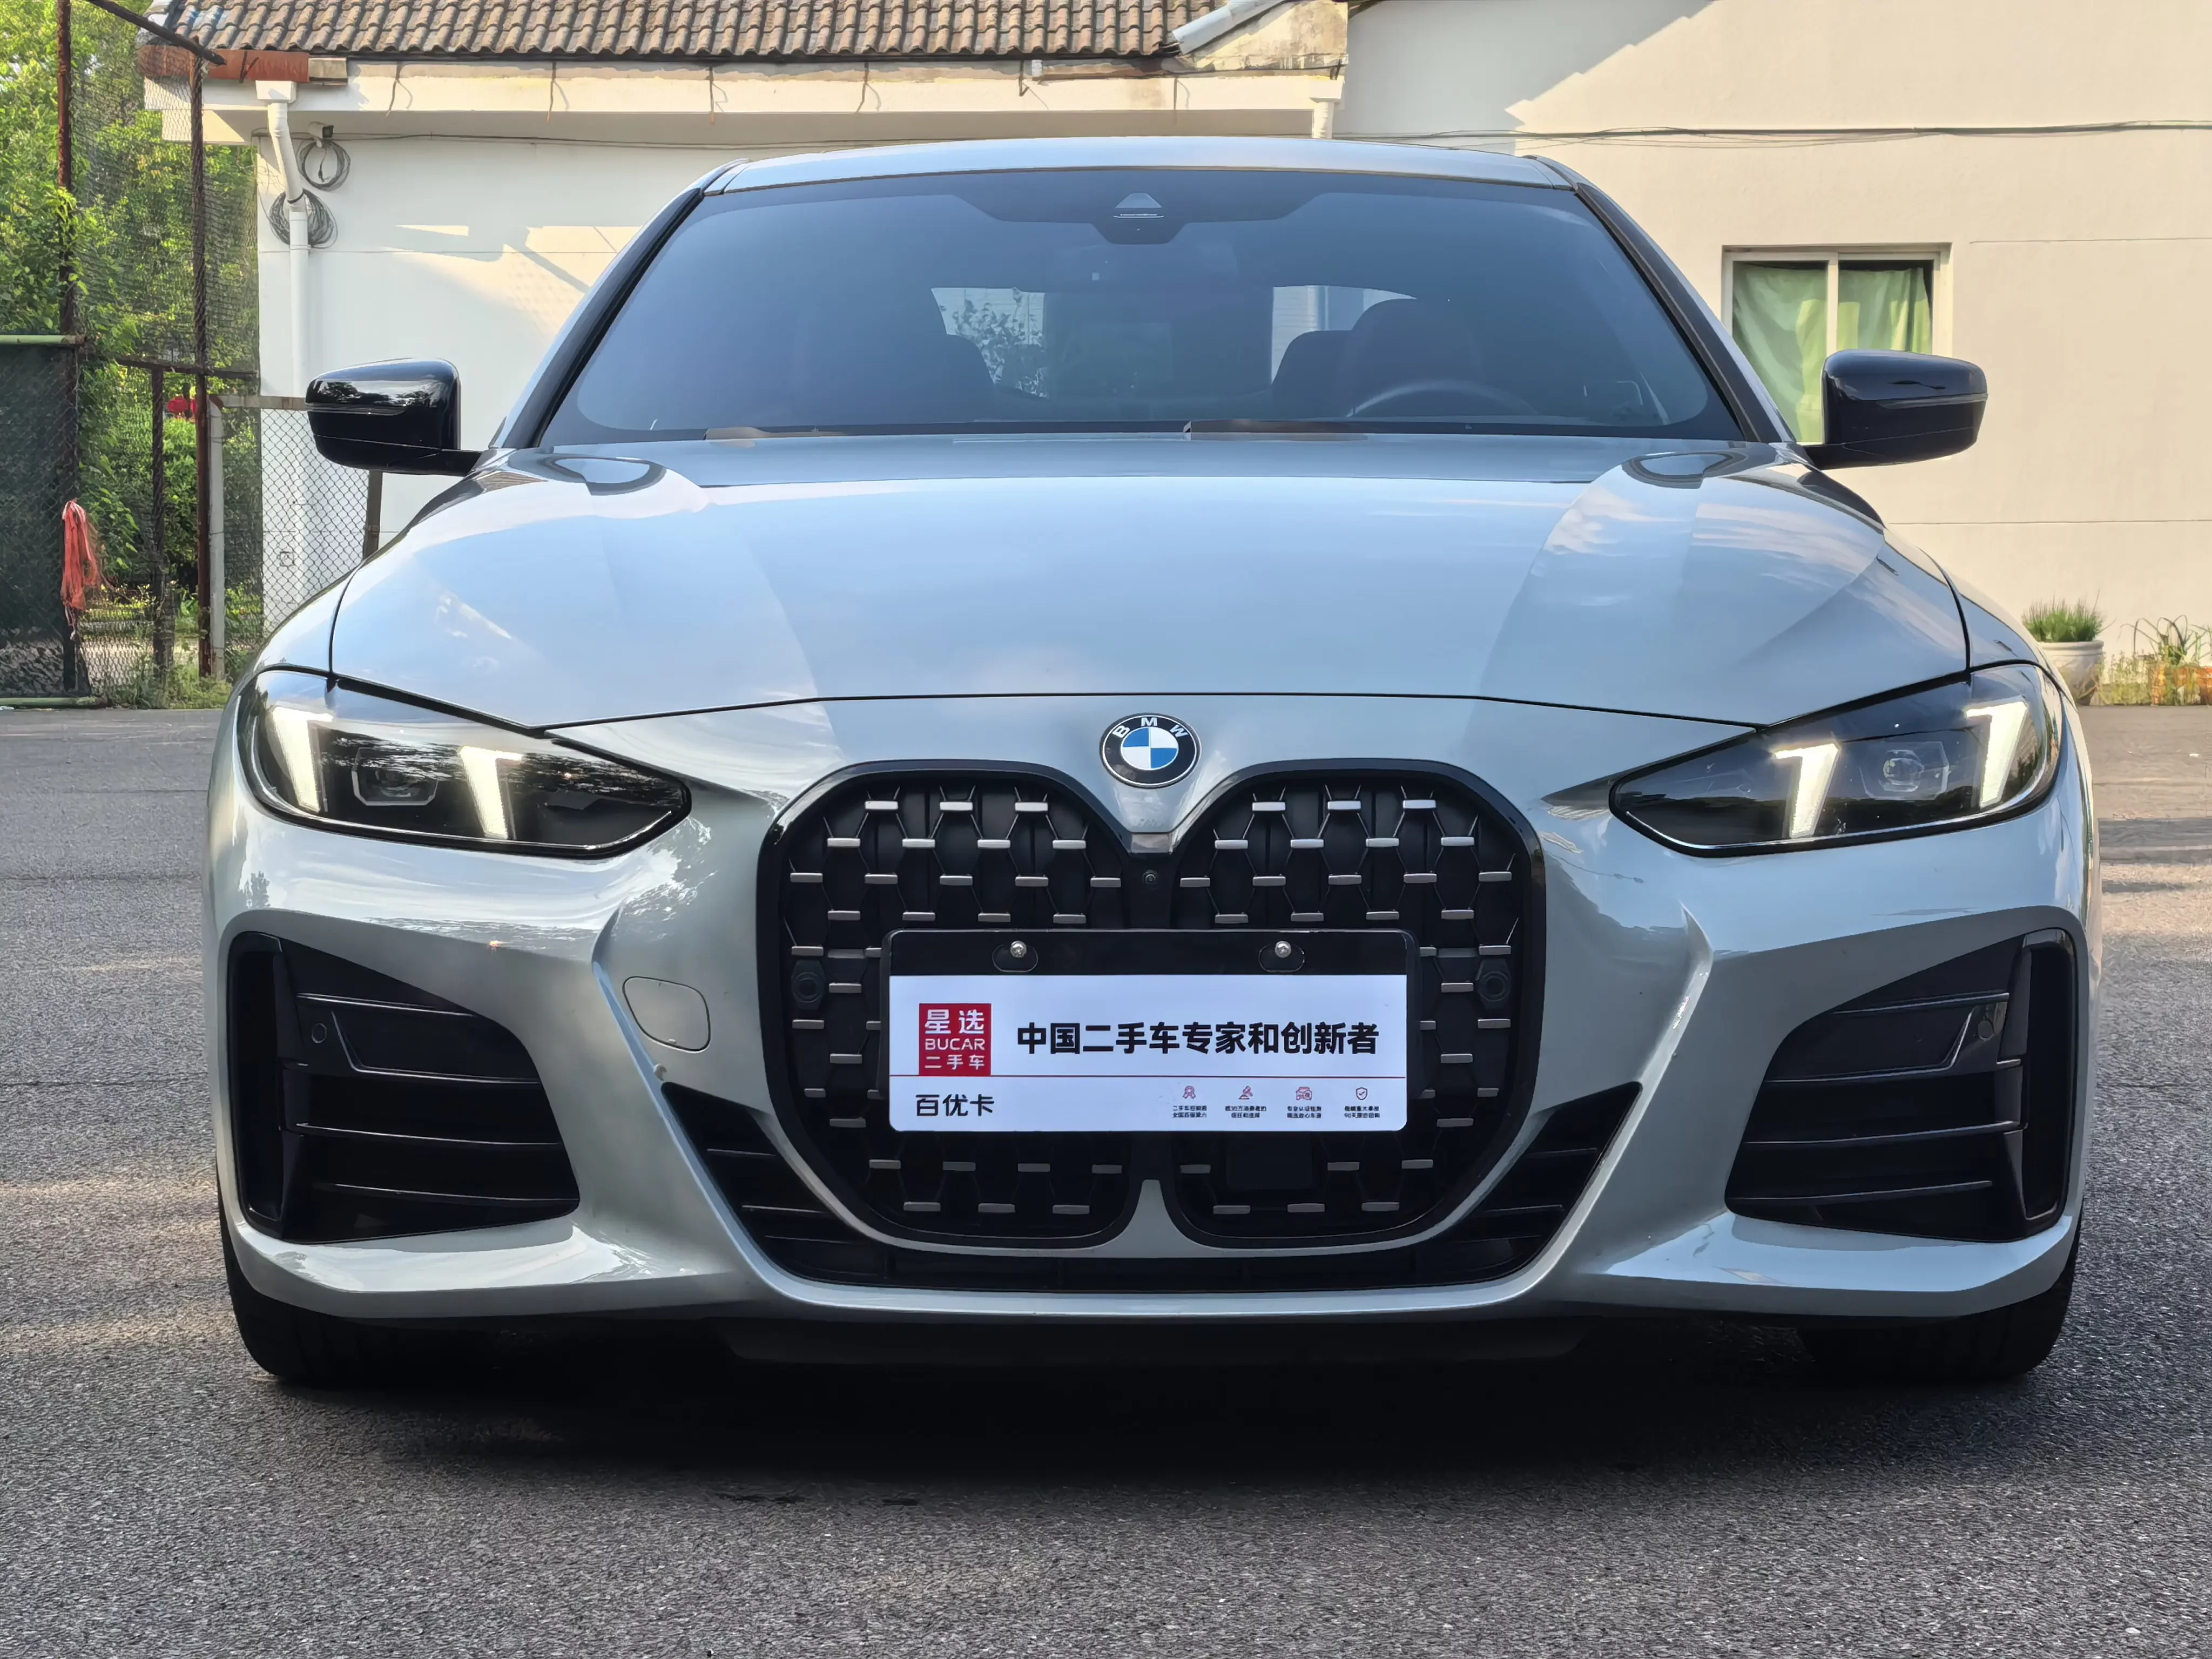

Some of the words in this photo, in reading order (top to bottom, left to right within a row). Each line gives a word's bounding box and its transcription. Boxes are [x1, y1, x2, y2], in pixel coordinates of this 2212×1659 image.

[1112, 717, 1188, 738] BMW
[925, 1009, 984, 1034] 星选
[925, 1038, 986, 1050] BUCAR
[1017, 1021, 1379, 1055] 中国二手车专家和创新者
[924, 1054, 984, 1070] 二手车
[915, 1094, 995, 1117] 百优卡
